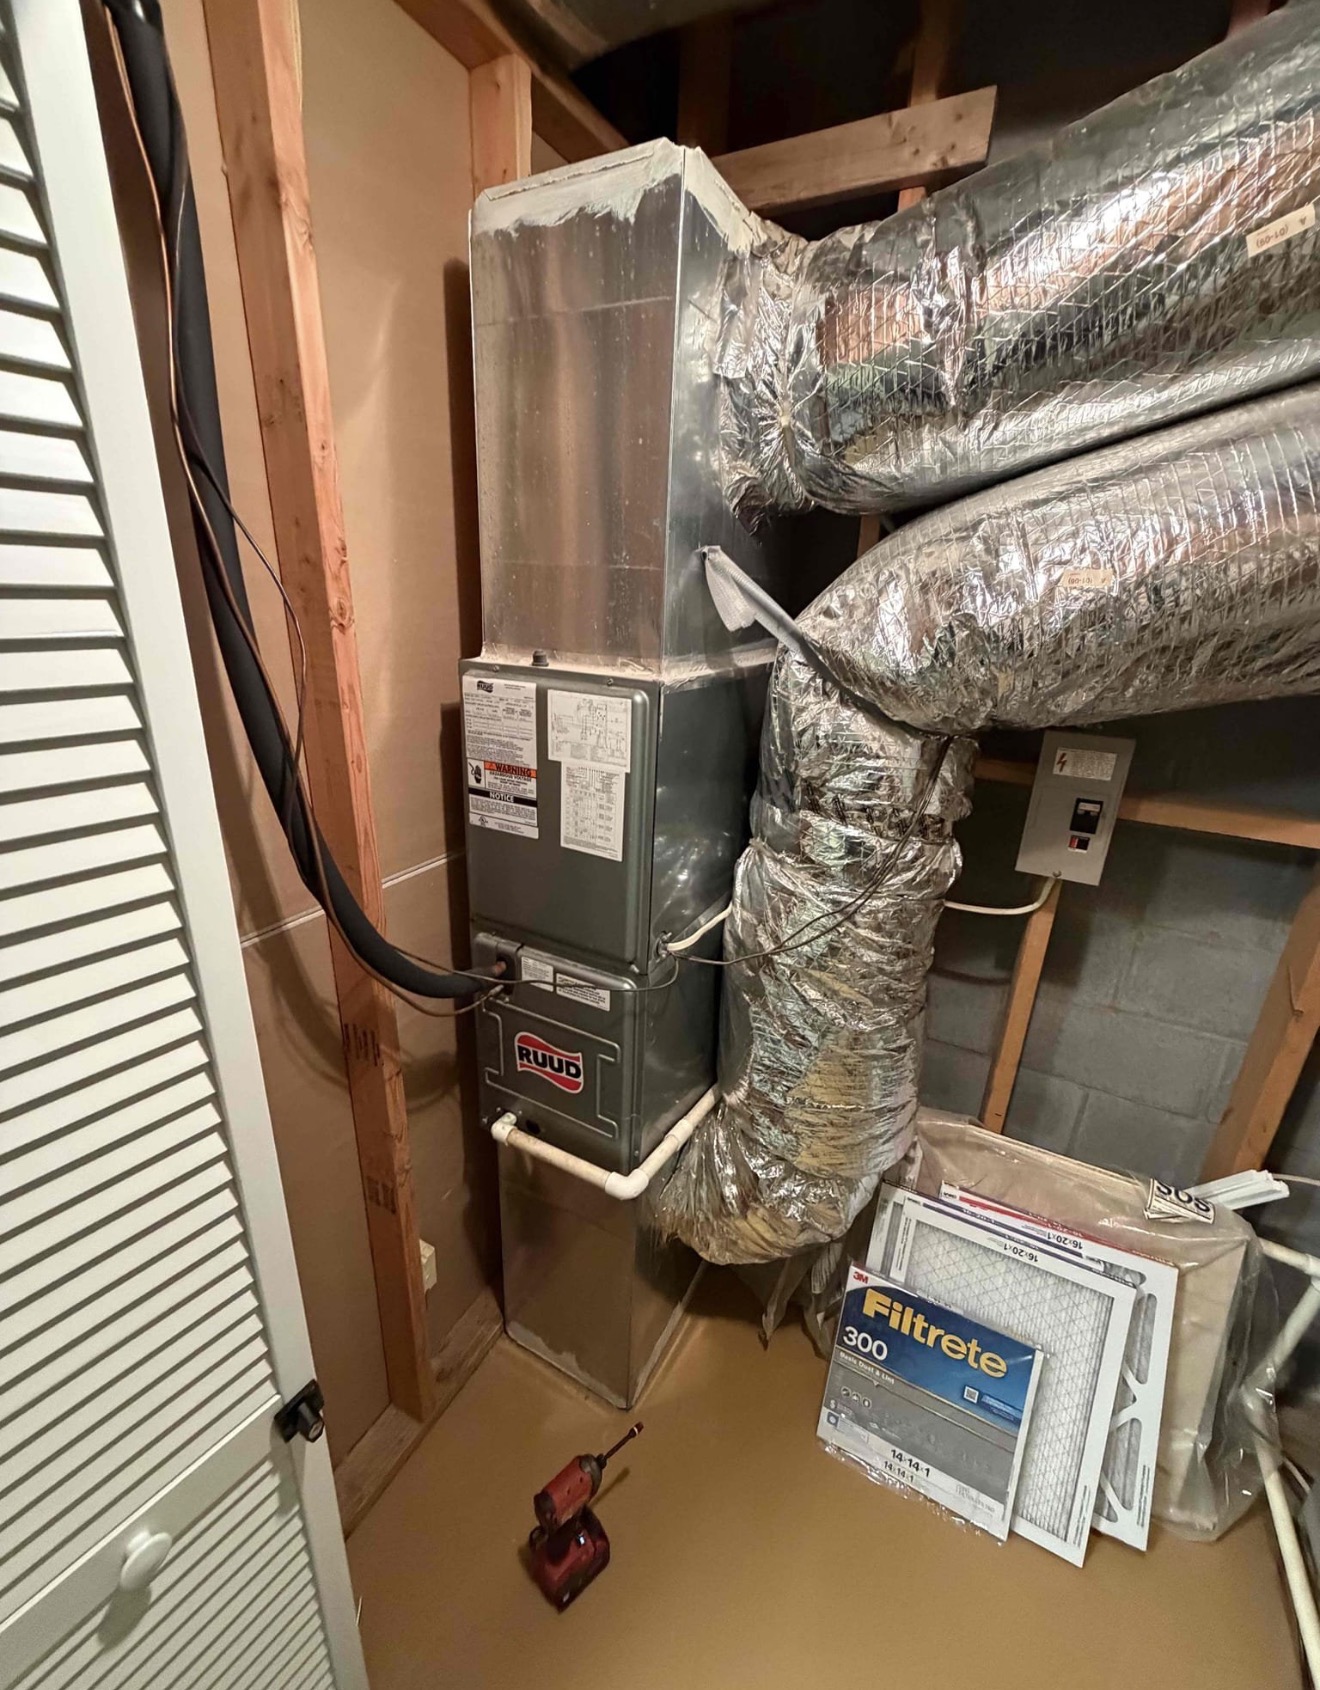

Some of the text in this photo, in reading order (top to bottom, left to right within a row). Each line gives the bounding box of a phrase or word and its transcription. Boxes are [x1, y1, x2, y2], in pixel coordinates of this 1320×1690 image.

[495, 763, 532, 777] WARNING
[489, 791, 515, 803] NOTICE
[517, 1045, 582, 1079] RUUD
[852, 1271, 869, 1284] 3M
[842, 1325, 888, 1361] 300
[862, 1288, 1008, 1378] Filtrete
